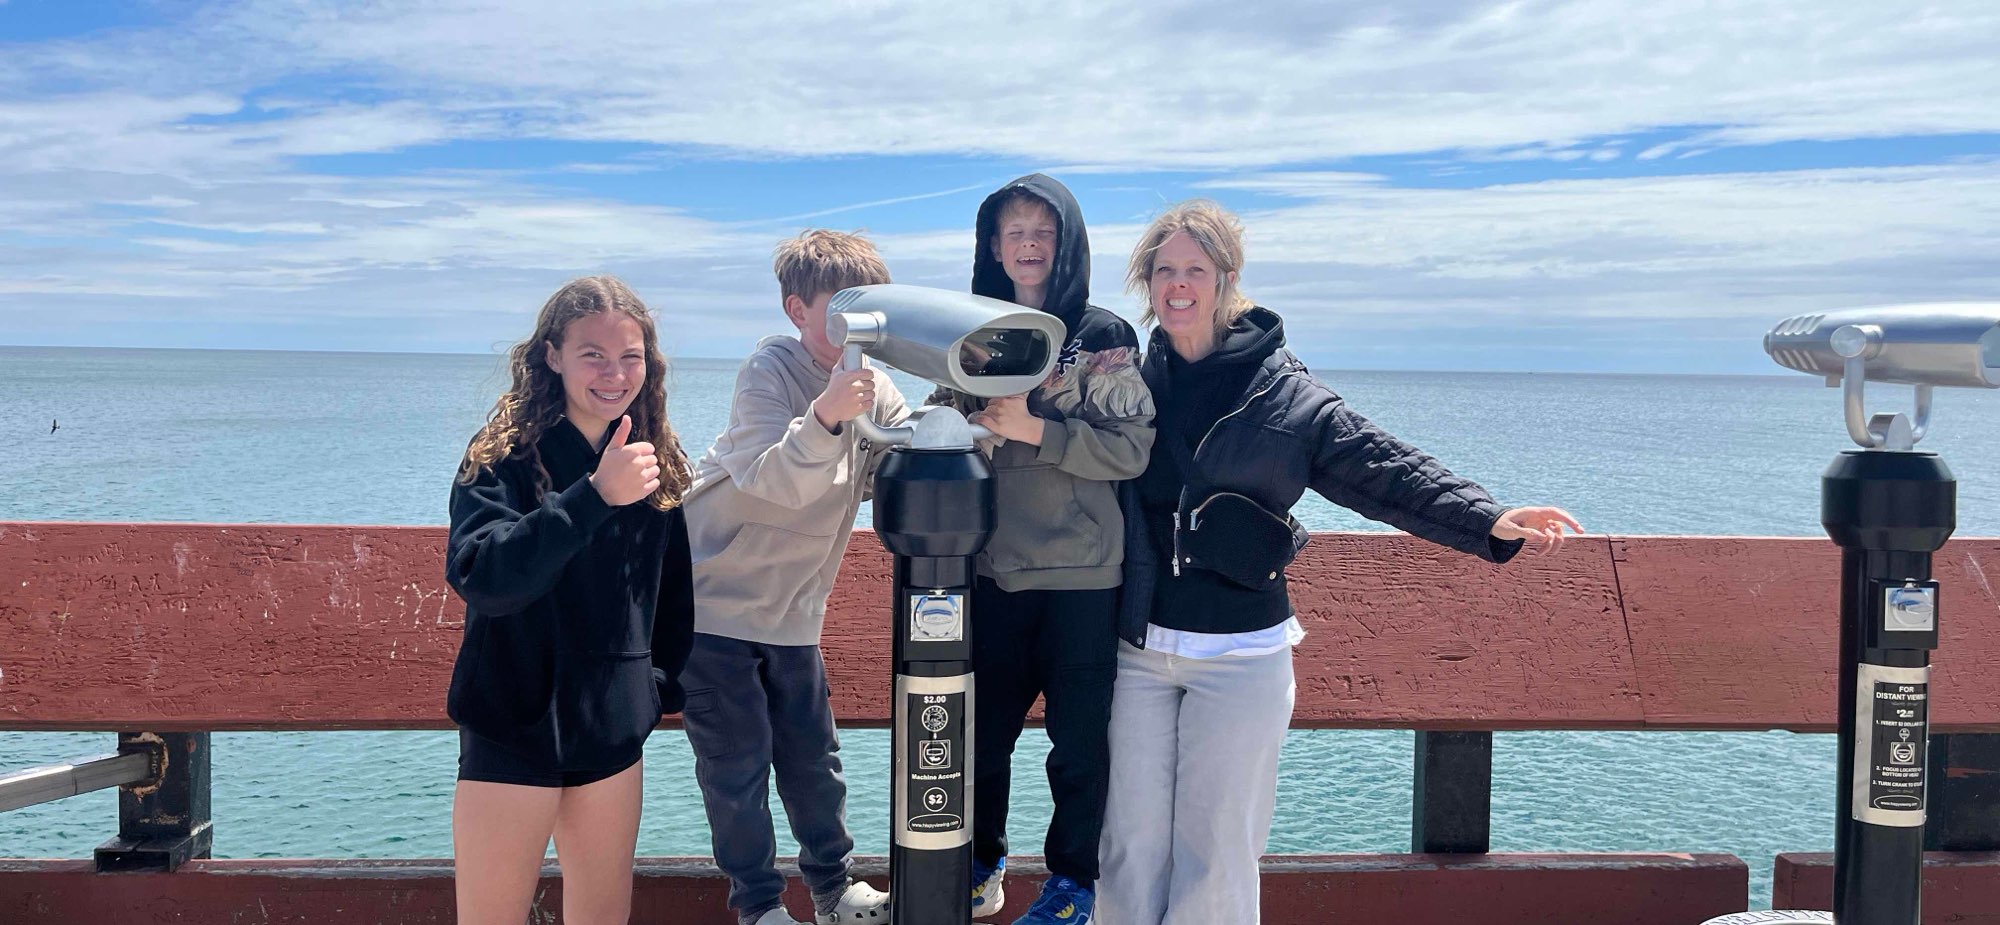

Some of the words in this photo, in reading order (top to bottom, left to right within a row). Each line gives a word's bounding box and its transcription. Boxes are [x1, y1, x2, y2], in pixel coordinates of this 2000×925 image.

[923, 695, 947, 704] $2.00
[1876, 691, 1906, 700] DISTANT
[928, 794, 943, 806] $2
